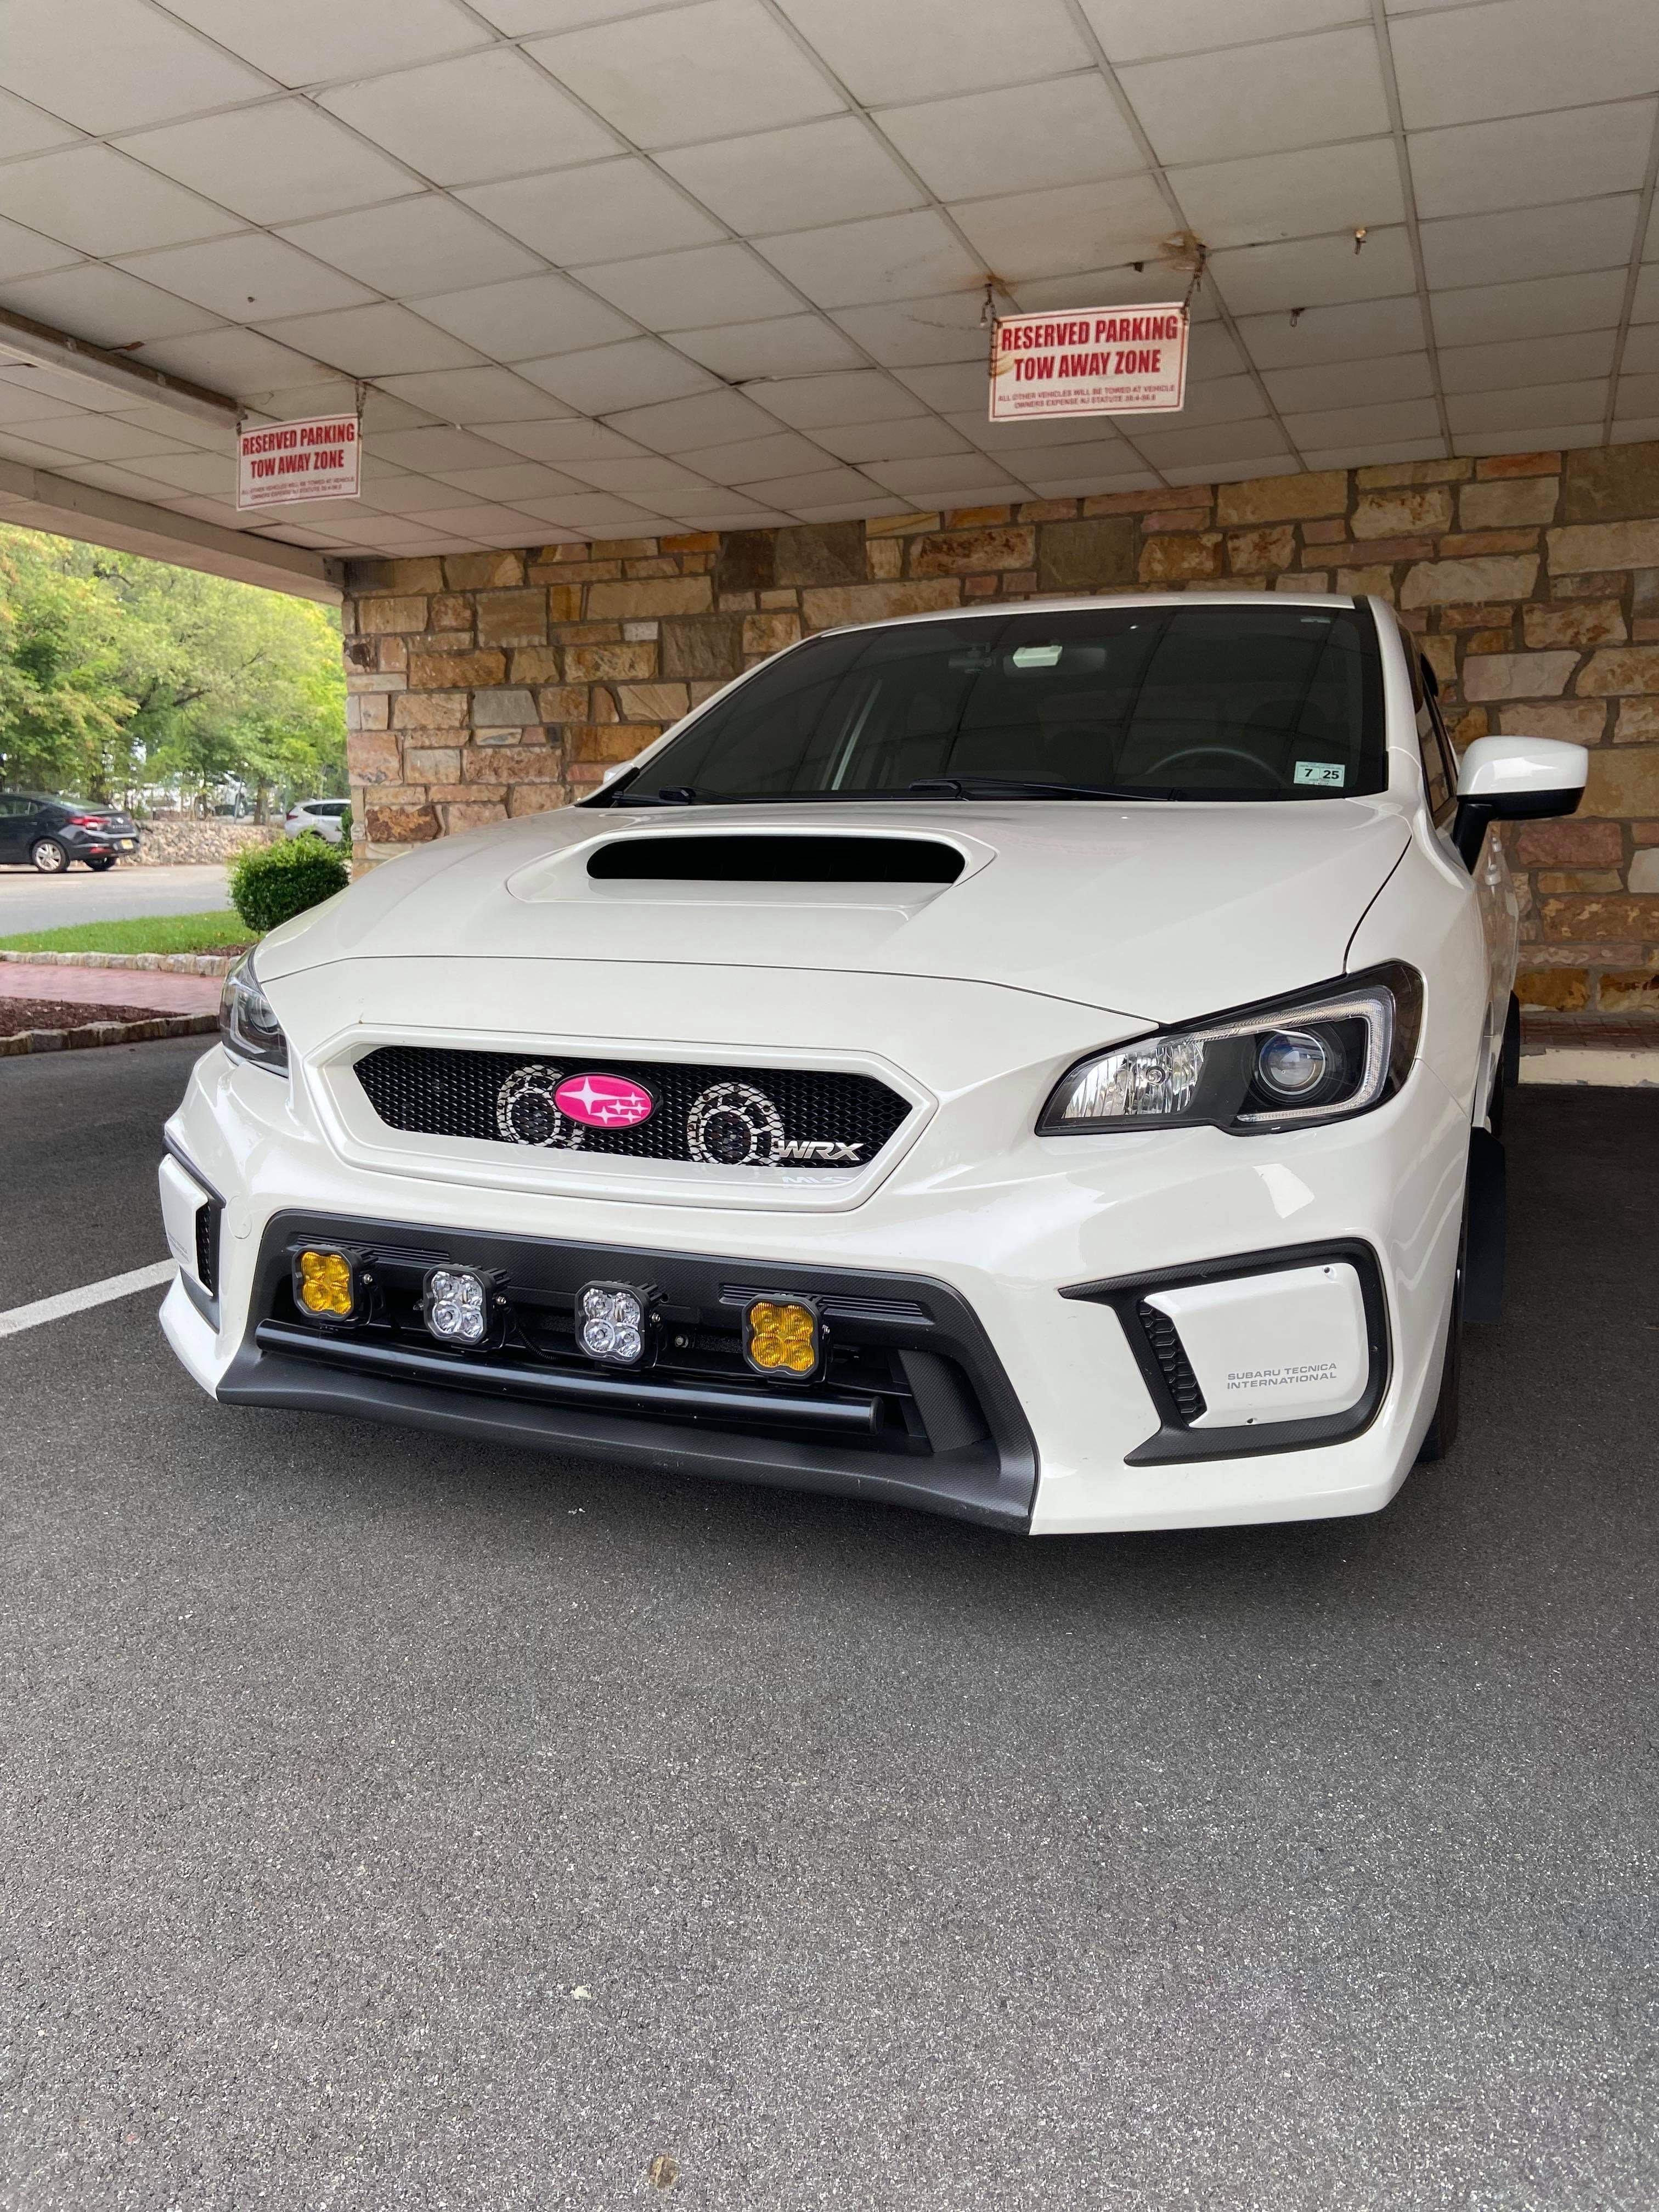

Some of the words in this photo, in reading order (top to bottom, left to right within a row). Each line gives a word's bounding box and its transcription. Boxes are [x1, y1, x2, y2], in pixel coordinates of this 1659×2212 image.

[1002, 321, 1090, 351] RESERVED
[1094, 316, 1178, 343] PARKING
[1014, 356, 1056, 381] TOW
[1059, 351, 1111, 377] AWAY
[1115, 349, 1161, 374] ZONE
[242, 430, 297, 456] RESERVED
[300, 423, 355, 447] PARKING
[251, 458, 275, 479] TOW
[278, 452, 311, 475] AWAY
[314, 450, 345, 470] ZONE
[1305, 769, 1313, 777] 7
[1323, 770, 1339, 779] 25
[778, 1140, 865, 1160] WRX
[1227, 1372, 1338, 1390] INTERNATIONAL
[1228, 1369, 1280, 1380] SUBARU
[1284, 1363, 1338, 1375] TECNICA
